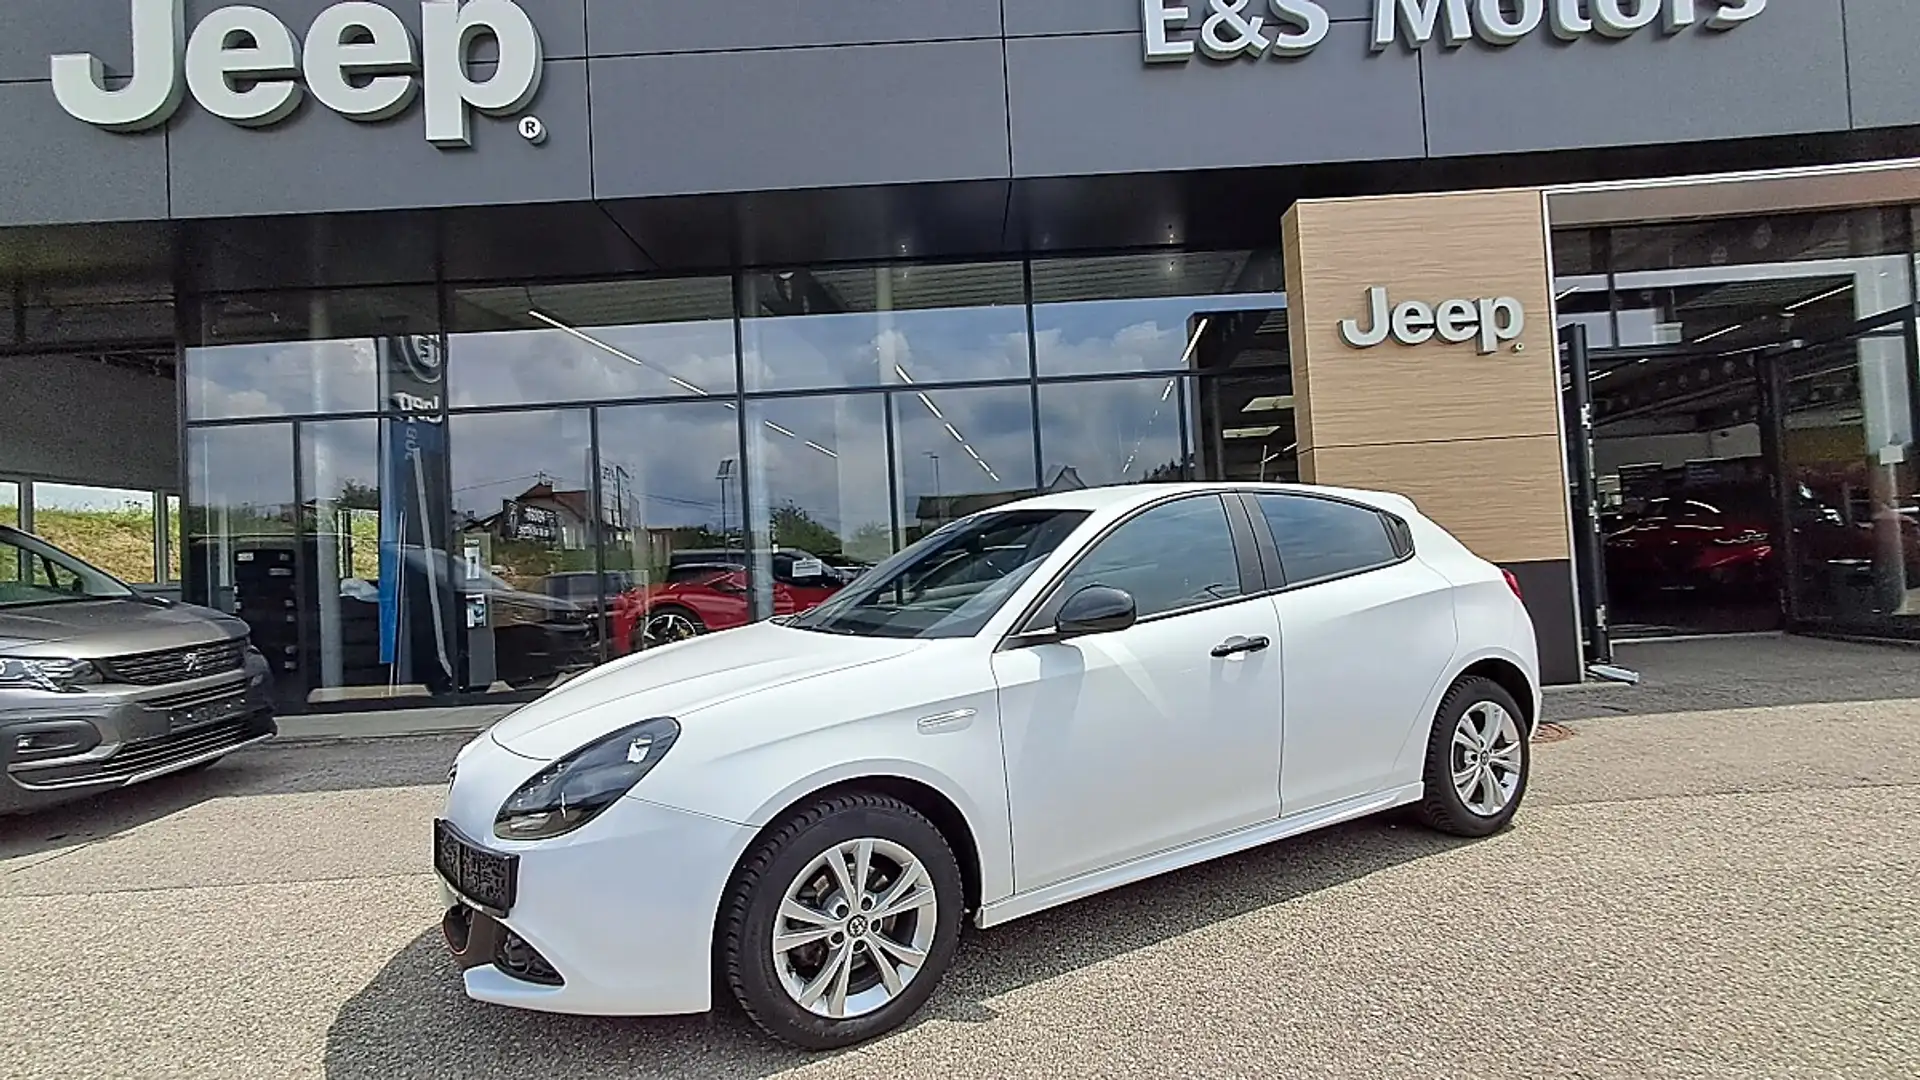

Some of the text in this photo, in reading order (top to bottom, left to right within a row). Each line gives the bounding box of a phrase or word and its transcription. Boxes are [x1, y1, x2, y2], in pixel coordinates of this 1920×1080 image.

[1143, 0, 1330, 61] E&S
[51, 0, 543, 147] Jeep
[1338, 286, 1525, 355] Jeep
